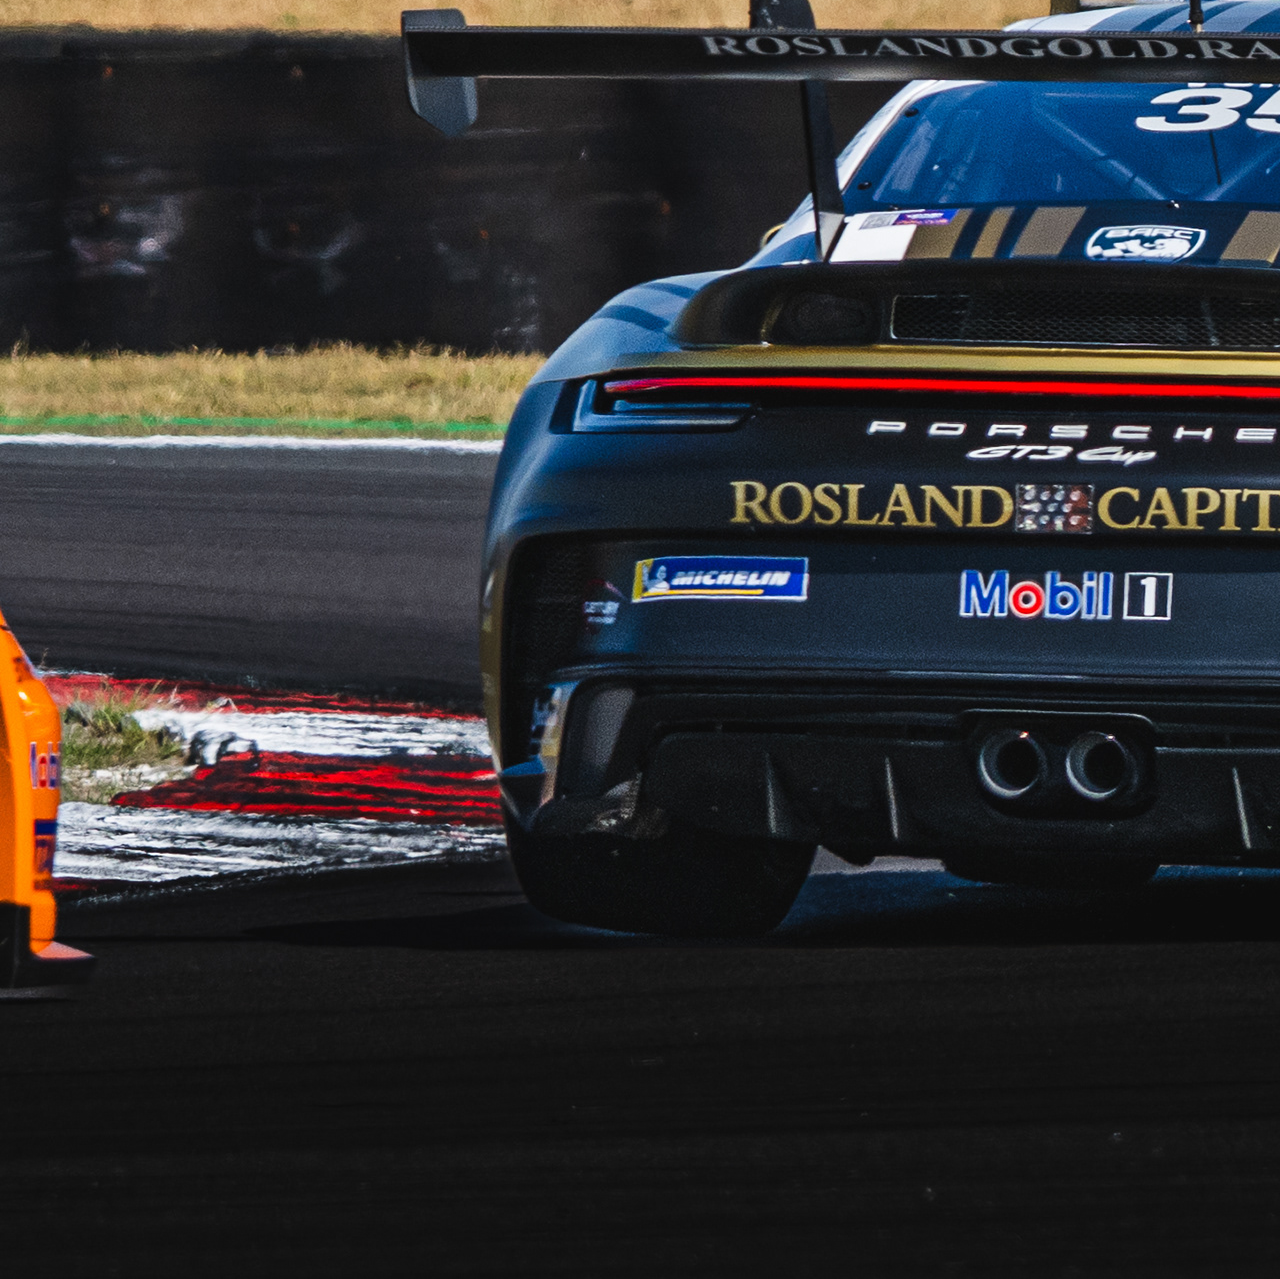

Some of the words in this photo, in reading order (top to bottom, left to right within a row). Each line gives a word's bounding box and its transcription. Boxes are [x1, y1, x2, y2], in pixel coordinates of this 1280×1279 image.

[1105, 228, 1194, 239] BARC
[867, 420, 1278, 443] PORSCHE
[967, 445, 1073, 461] GT3
[1076, 445, 1158, 466] Cup
[729, 480, 1015, 527] ROSLAND
[671, 571, 792, 586] MICHELIN
[959, 570, 1113, 621] Mobil
